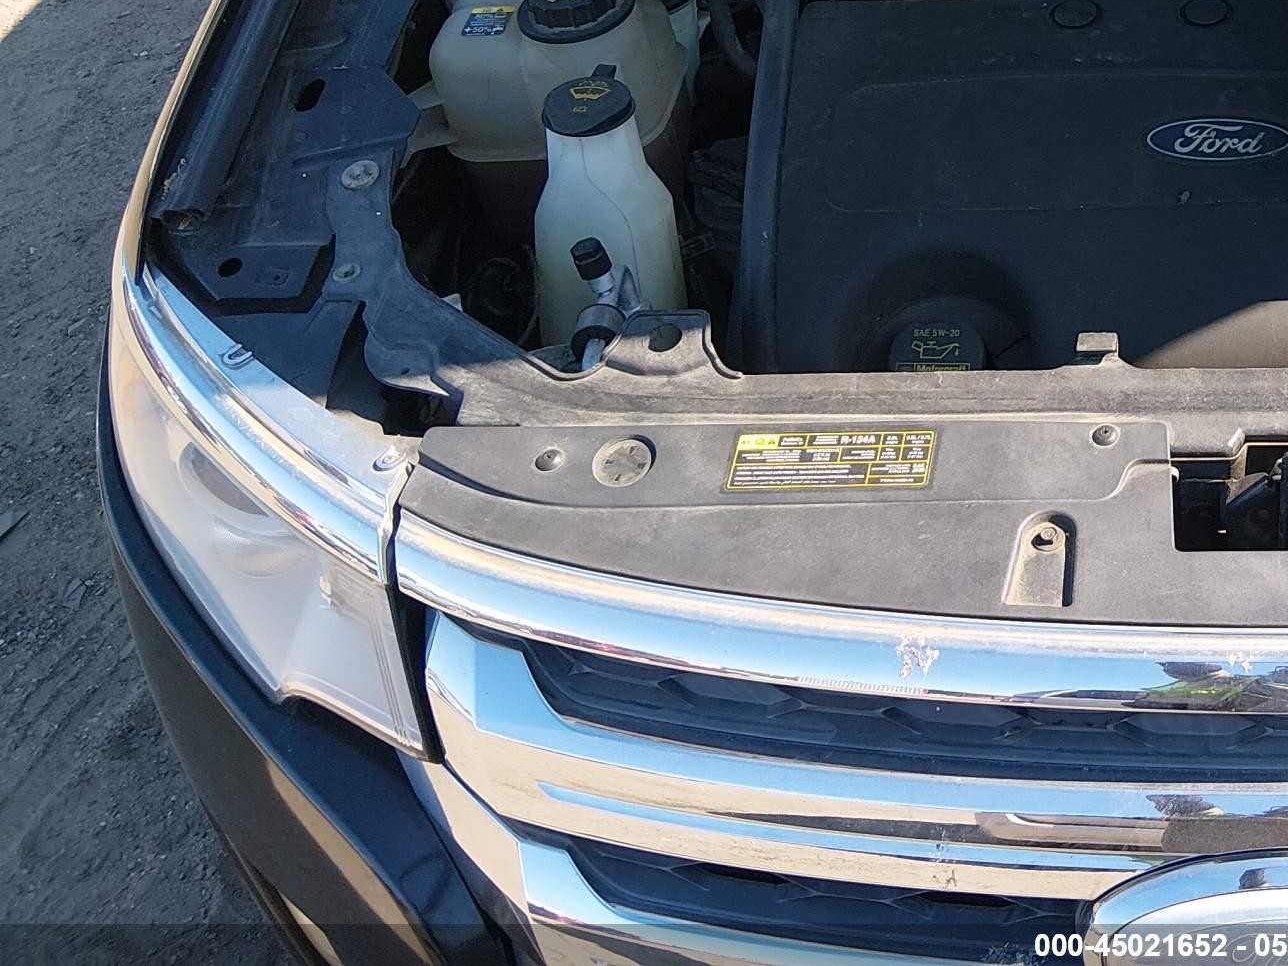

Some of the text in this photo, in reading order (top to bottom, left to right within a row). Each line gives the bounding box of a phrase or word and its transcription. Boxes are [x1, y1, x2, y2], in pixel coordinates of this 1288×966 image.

[1174, 123, 1264, 154] Ford
[913, 329, 960, 337] SAE 5W-20
[840, 435, 876, 445] R-134A
